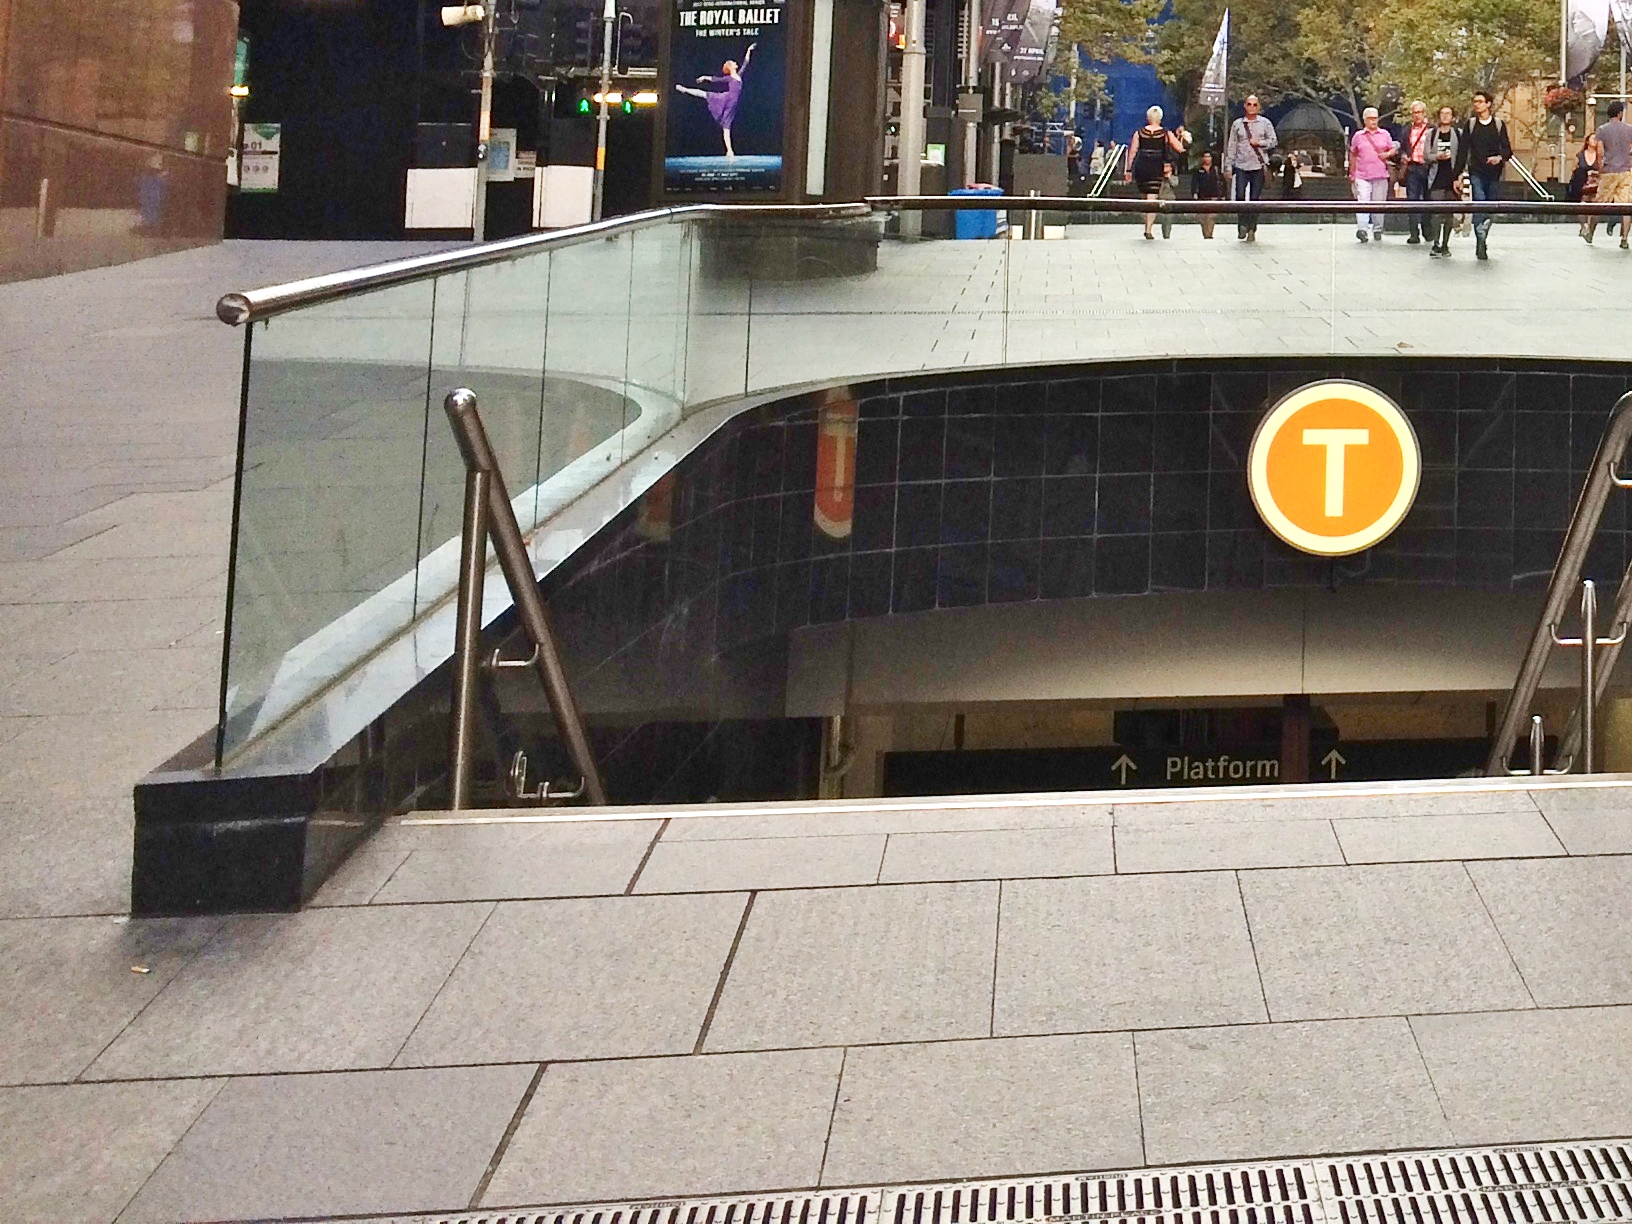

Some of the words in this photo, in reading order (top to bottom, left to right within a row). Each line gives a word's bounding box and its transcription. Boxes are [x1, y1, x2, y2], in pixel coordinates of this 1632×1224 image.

[680, 11, 698, 26] THE
[700, 9, 735, 26] ROYAL
[738, 8, 781, 24] BALLET
[695, 29, 707, 37] THE
[709, 28, 741, 37] WINTER'S
[743, 27, 760, 36] TALE
[1302, 428, 1369, 517] T
[1166, 755, 1280, 780] Platform
